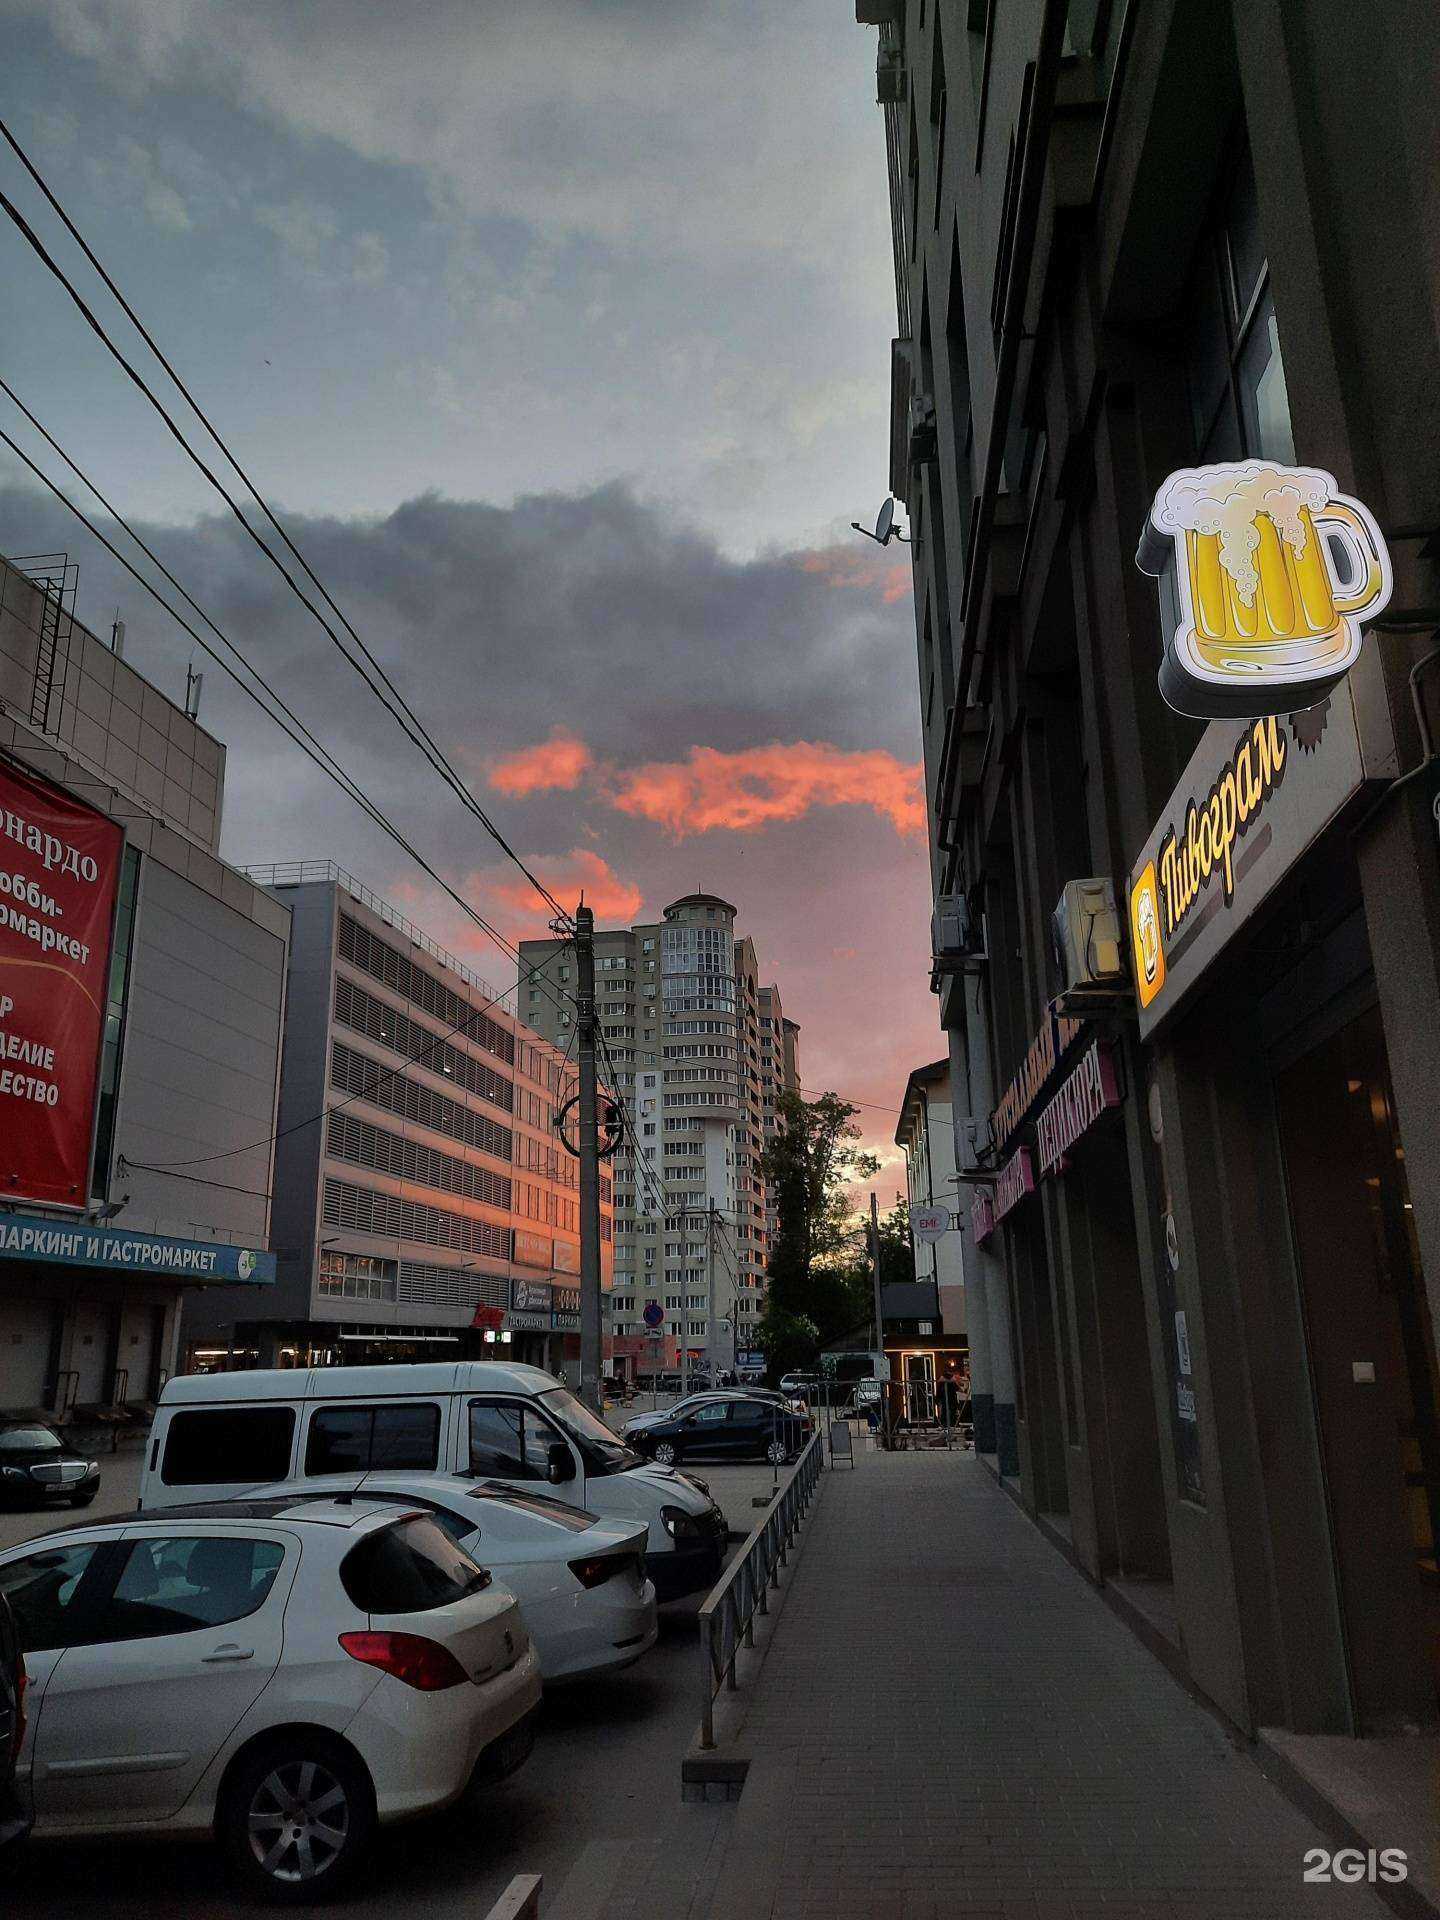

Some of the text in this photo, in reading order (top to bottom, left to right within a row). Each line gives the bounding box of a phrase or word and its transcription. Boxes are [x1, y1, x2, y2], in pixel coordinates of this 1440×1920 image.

[1161, 714, 1285, 934] Пивограм
[86, 1238, 99, 1259] И
[102, 1239, 217, 1271] ГАСТРОМАРКЕТ
